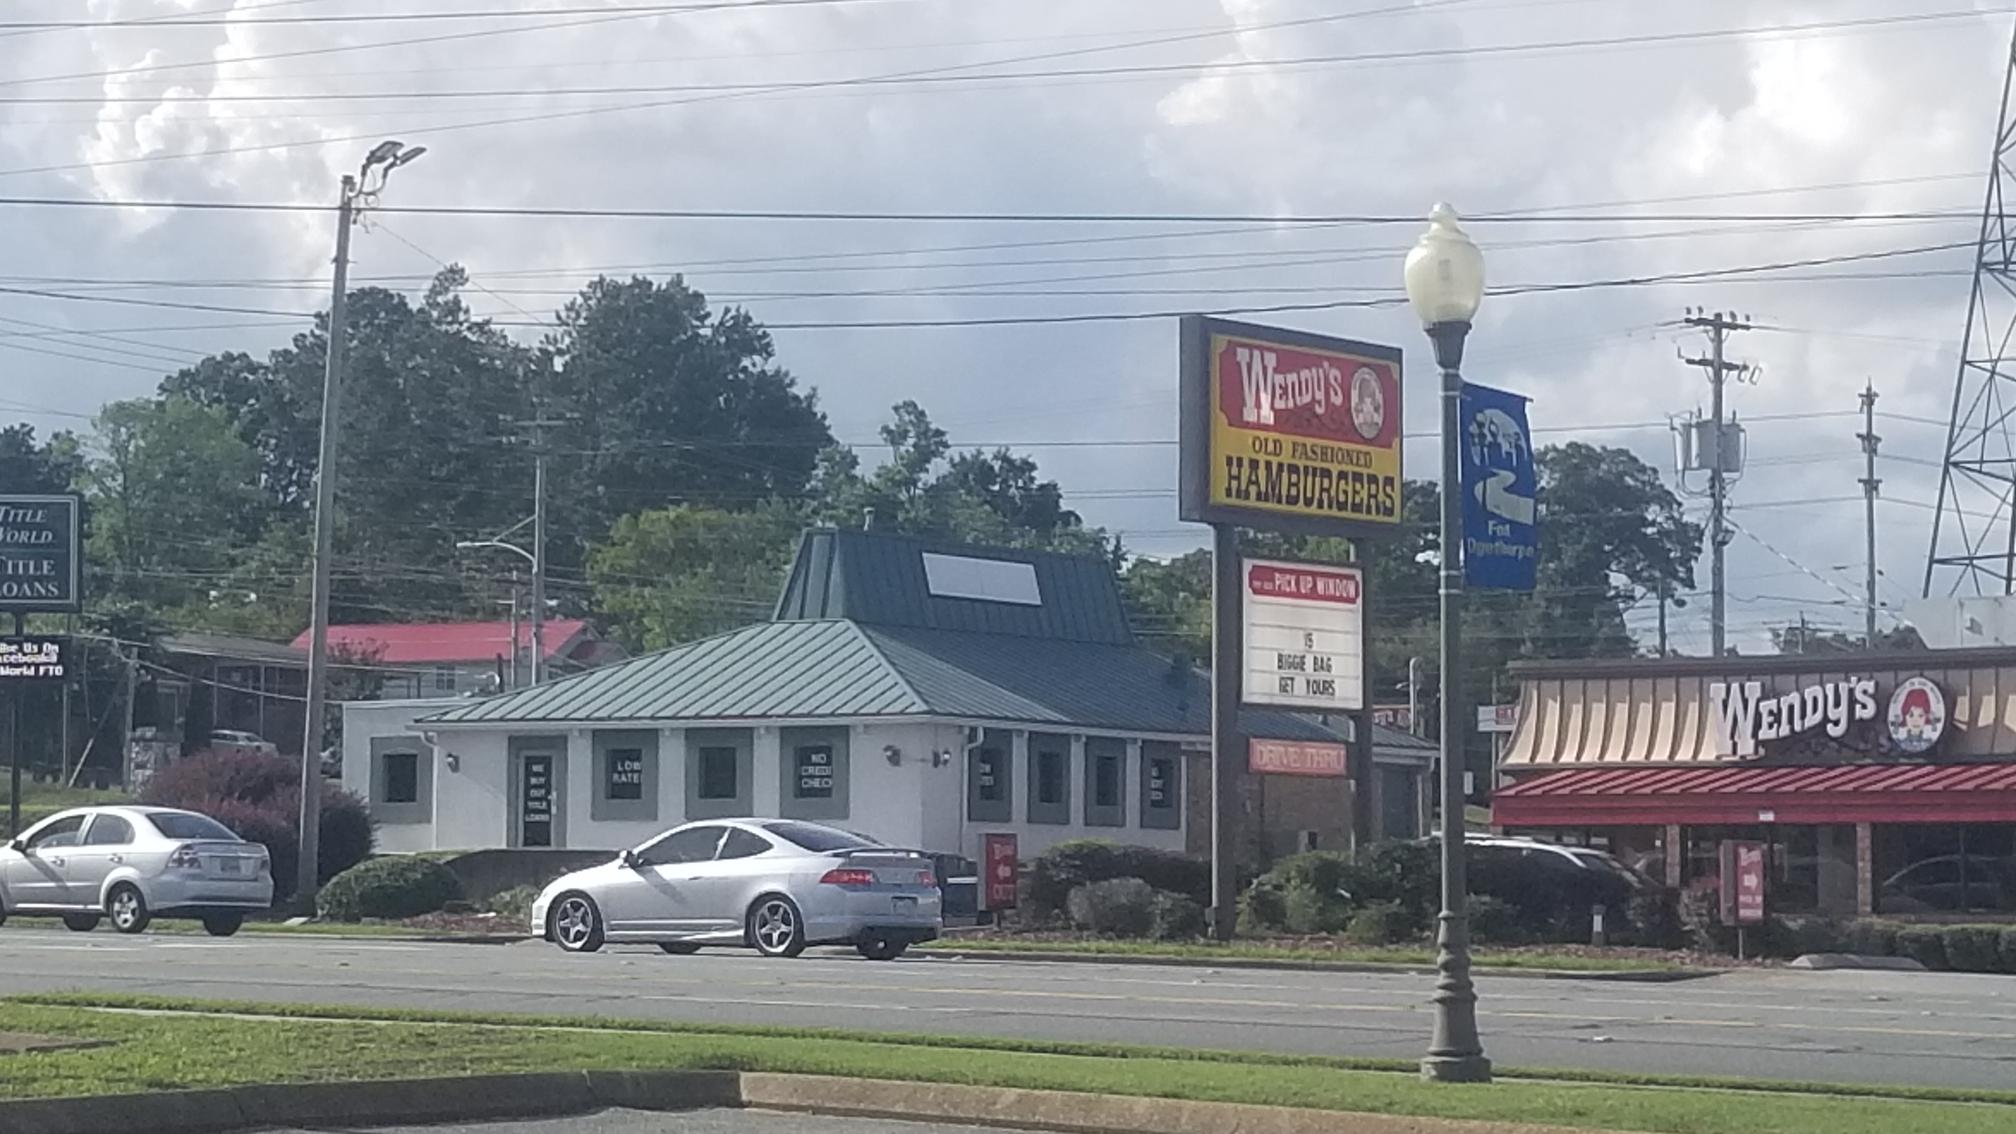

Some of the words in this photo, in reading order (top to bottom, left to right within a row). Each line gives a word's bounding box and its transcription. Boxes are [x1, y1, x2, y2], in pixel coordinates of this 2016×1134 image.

[1236, 348, 1343, 425] Wendy's
[1252, 436, 1283, 457] OLD
[1291, 441, 1373, 468] FASHIONED
[1225, 455, 1395, 517] HAMBURGERS
[0, 557, 56, 576] ITLE
[0, 582, 59, 597] OANS
[1274, 572, 1297, 593] PICK
[1300, 575, 1313, 593] UP
[1317, 577, 1356, 599] WINDOW
[1278, 653, 1306, 672] BIGGIE
[1313, 655, 1333, 674] BAG
[1306, 679, 1336, 697] YOURS
[1710, 676, 1877, 761] Wendy's
